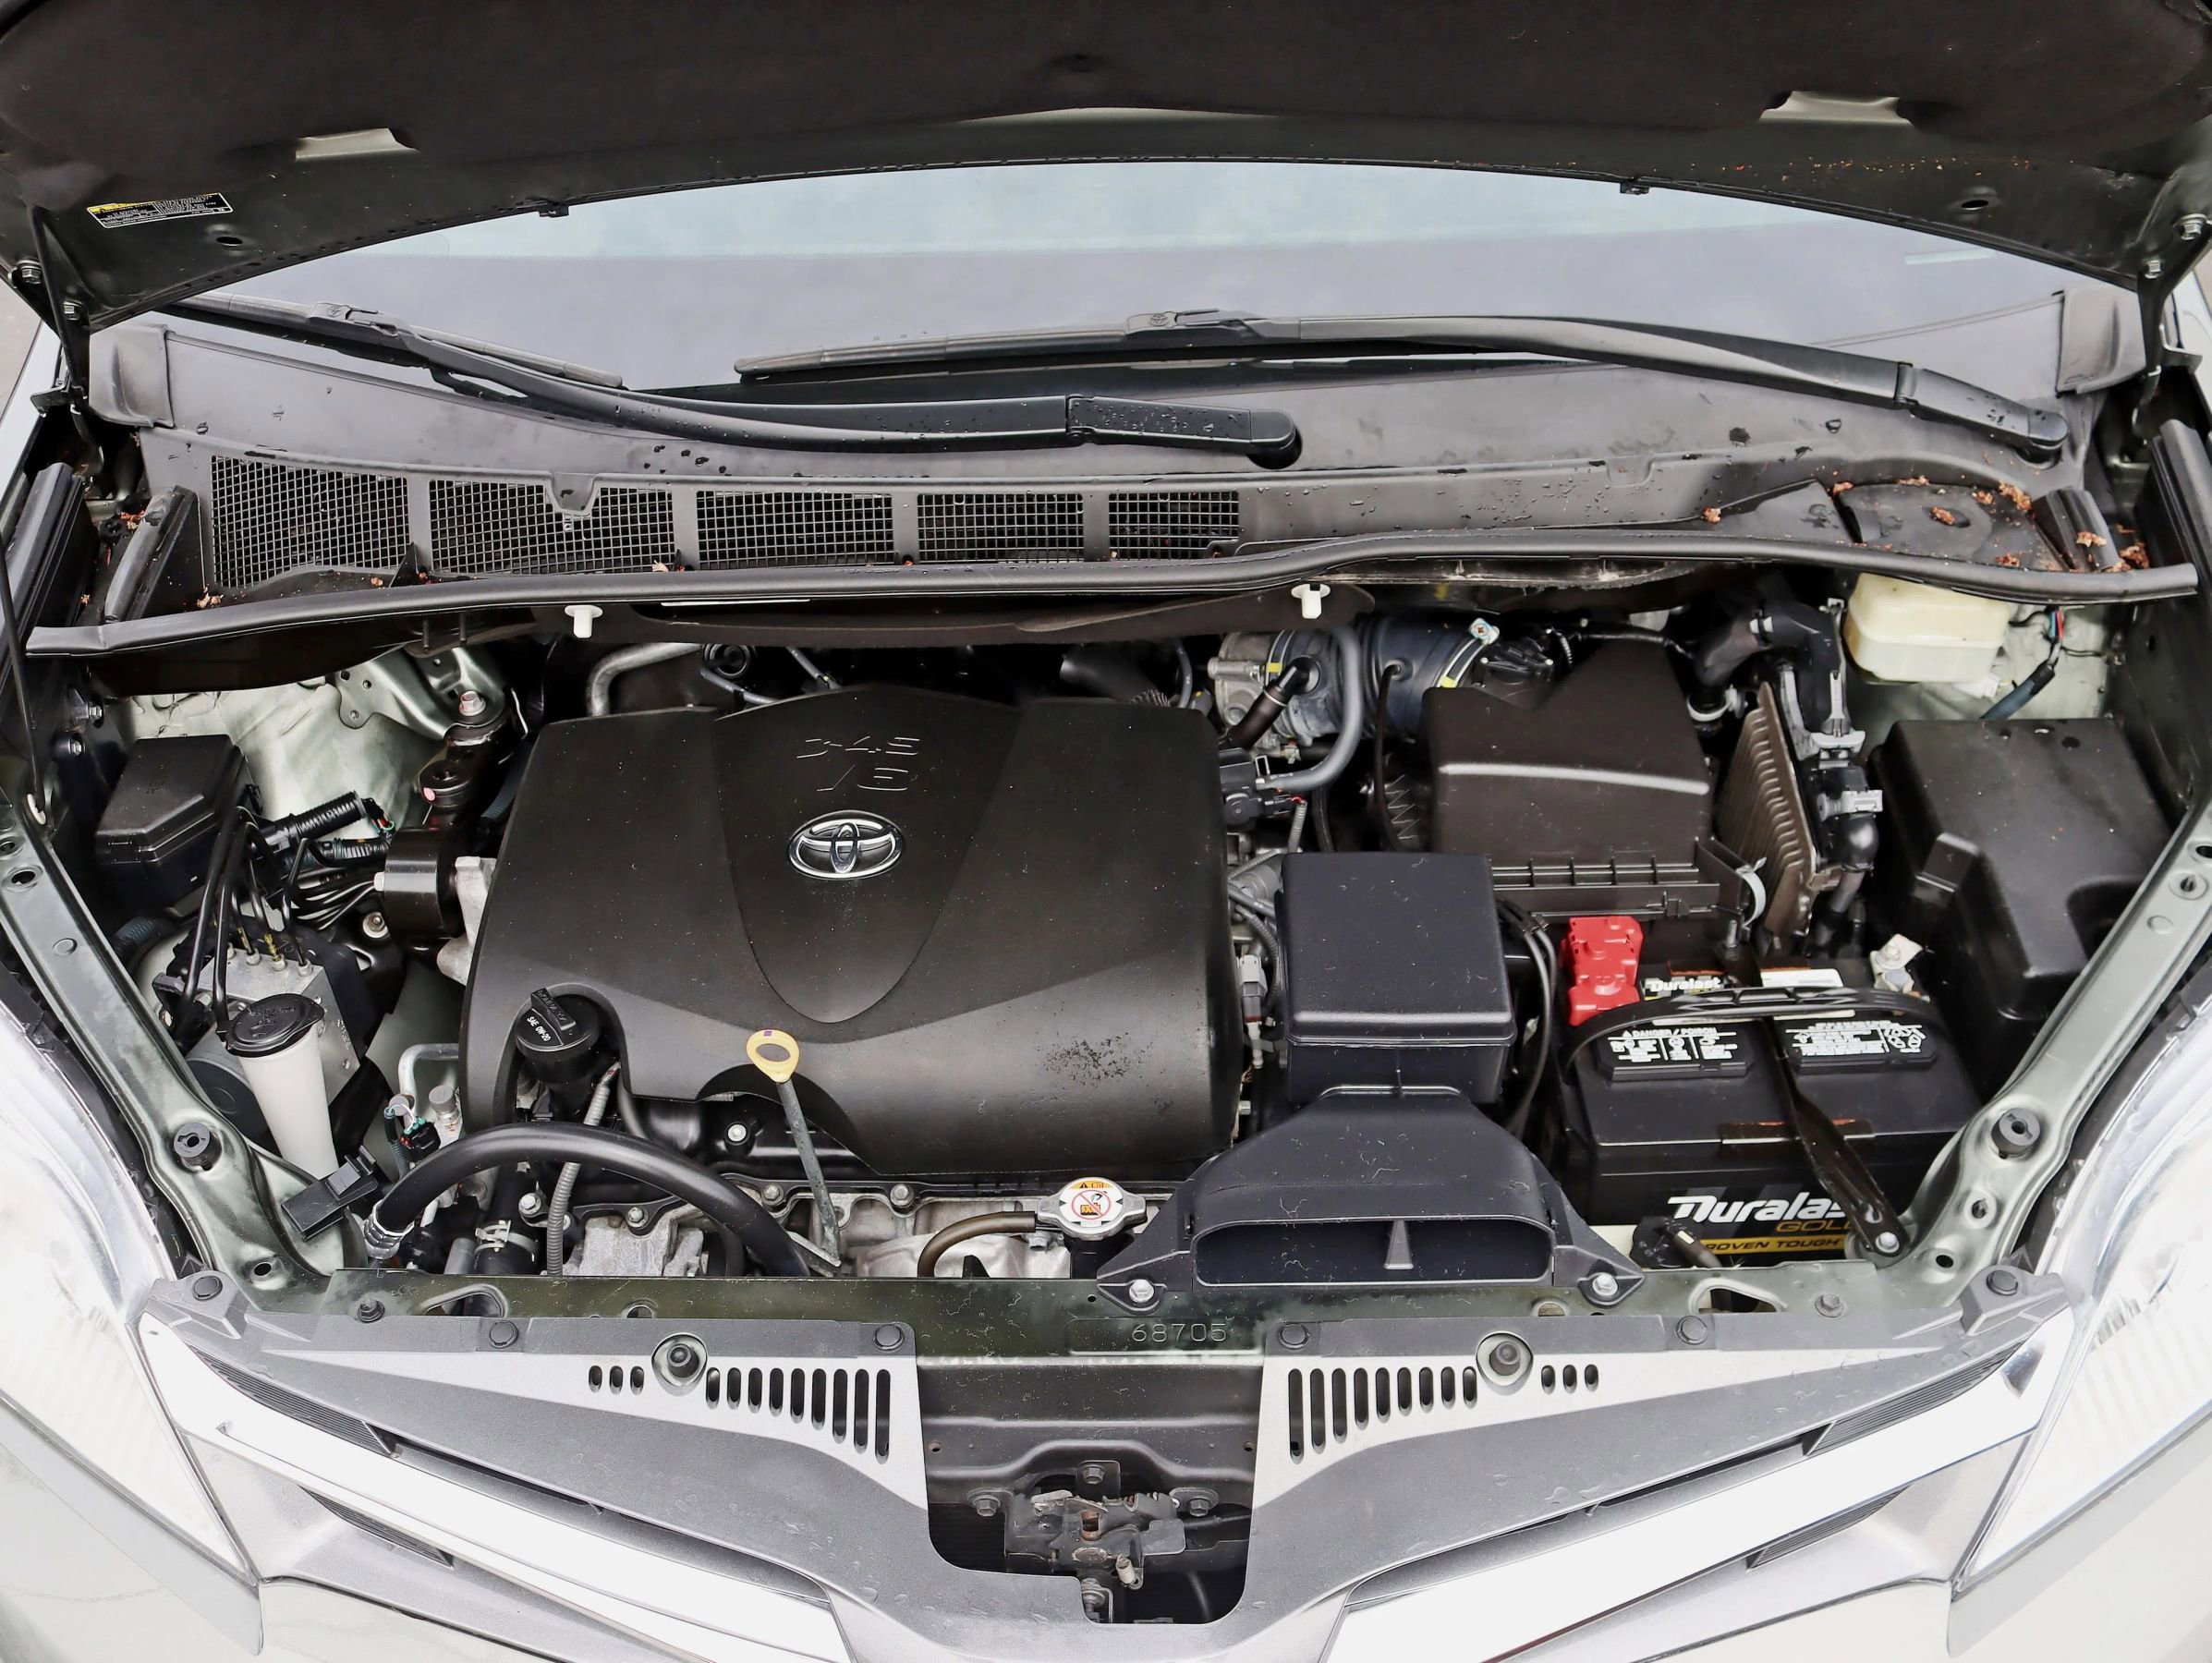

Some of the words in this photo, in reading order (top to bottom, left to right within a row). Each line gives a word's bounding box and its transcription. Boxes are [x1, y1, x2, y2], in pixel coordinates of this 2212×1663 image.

[1645, 977, 1721, 992] Duralast
[527, 1016, 538, 1026] SAE
[1776, 1238, 1841, 1249] TOUGH
[1131, 1323, 1227, 1342] 68705
